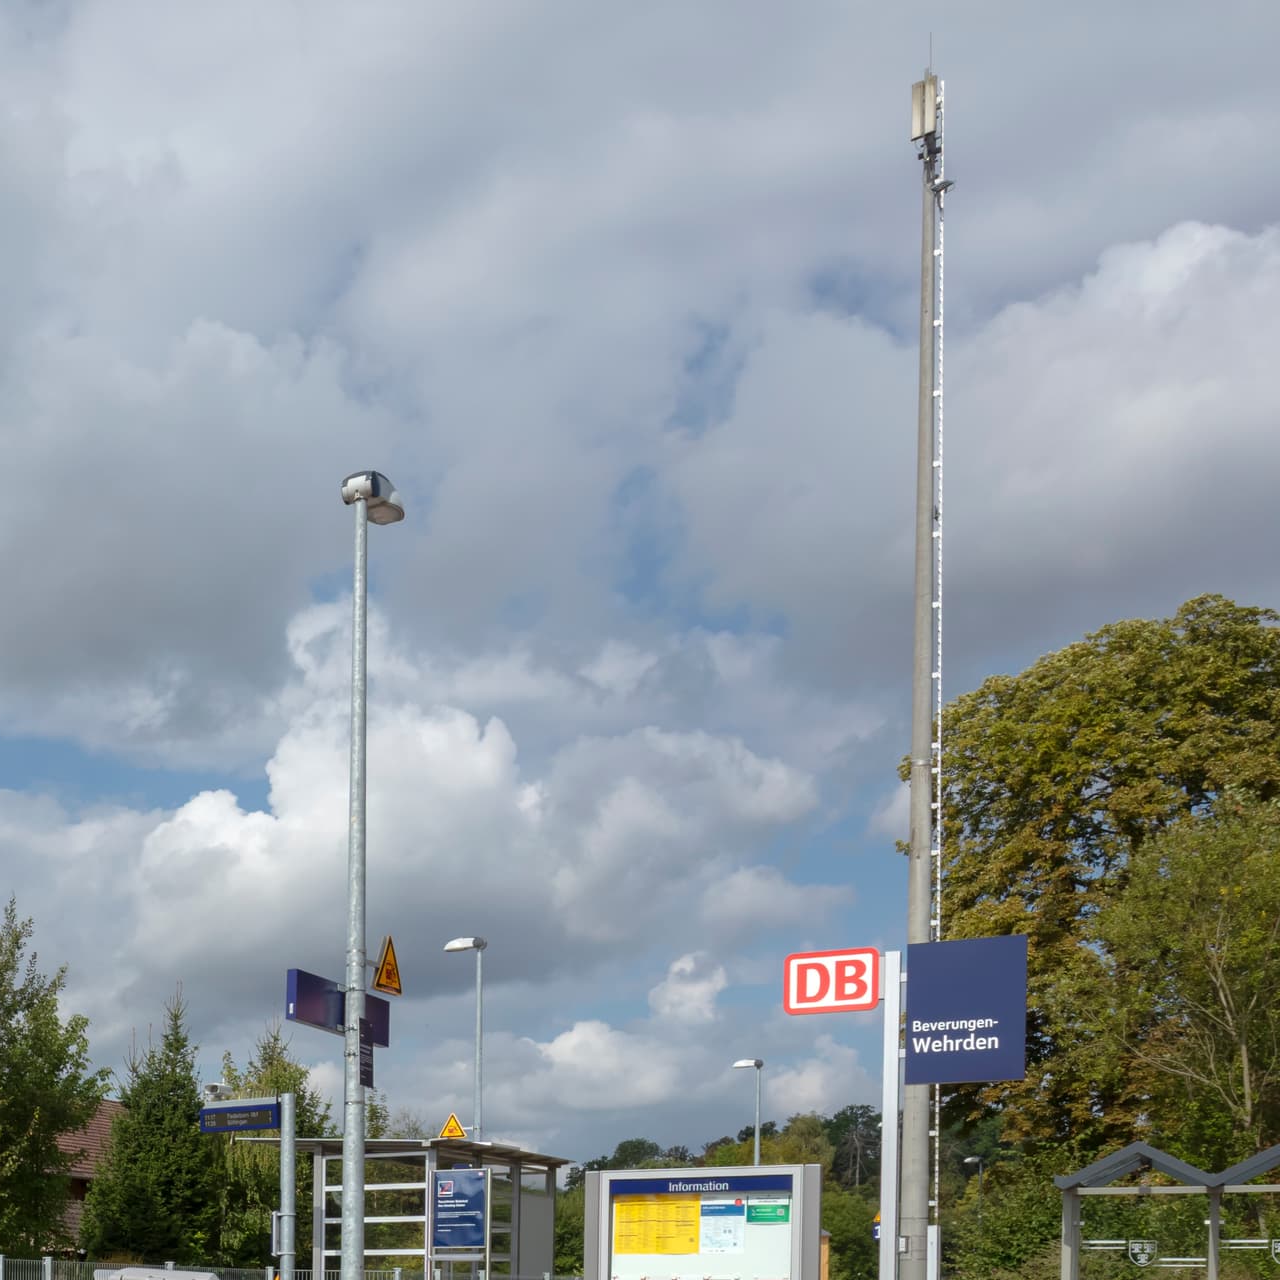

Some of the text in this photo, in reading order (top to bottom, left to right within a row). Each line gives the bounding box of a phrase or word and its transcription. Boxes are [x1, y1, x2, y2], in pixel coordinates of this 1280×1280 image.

[796, 959, 868, 1004] DB
[912, 1018, 999, 1032] Beverungen-
[912, 1033, 999, 1053] Wehrden
[668, 1181, 729, 1193] Information
